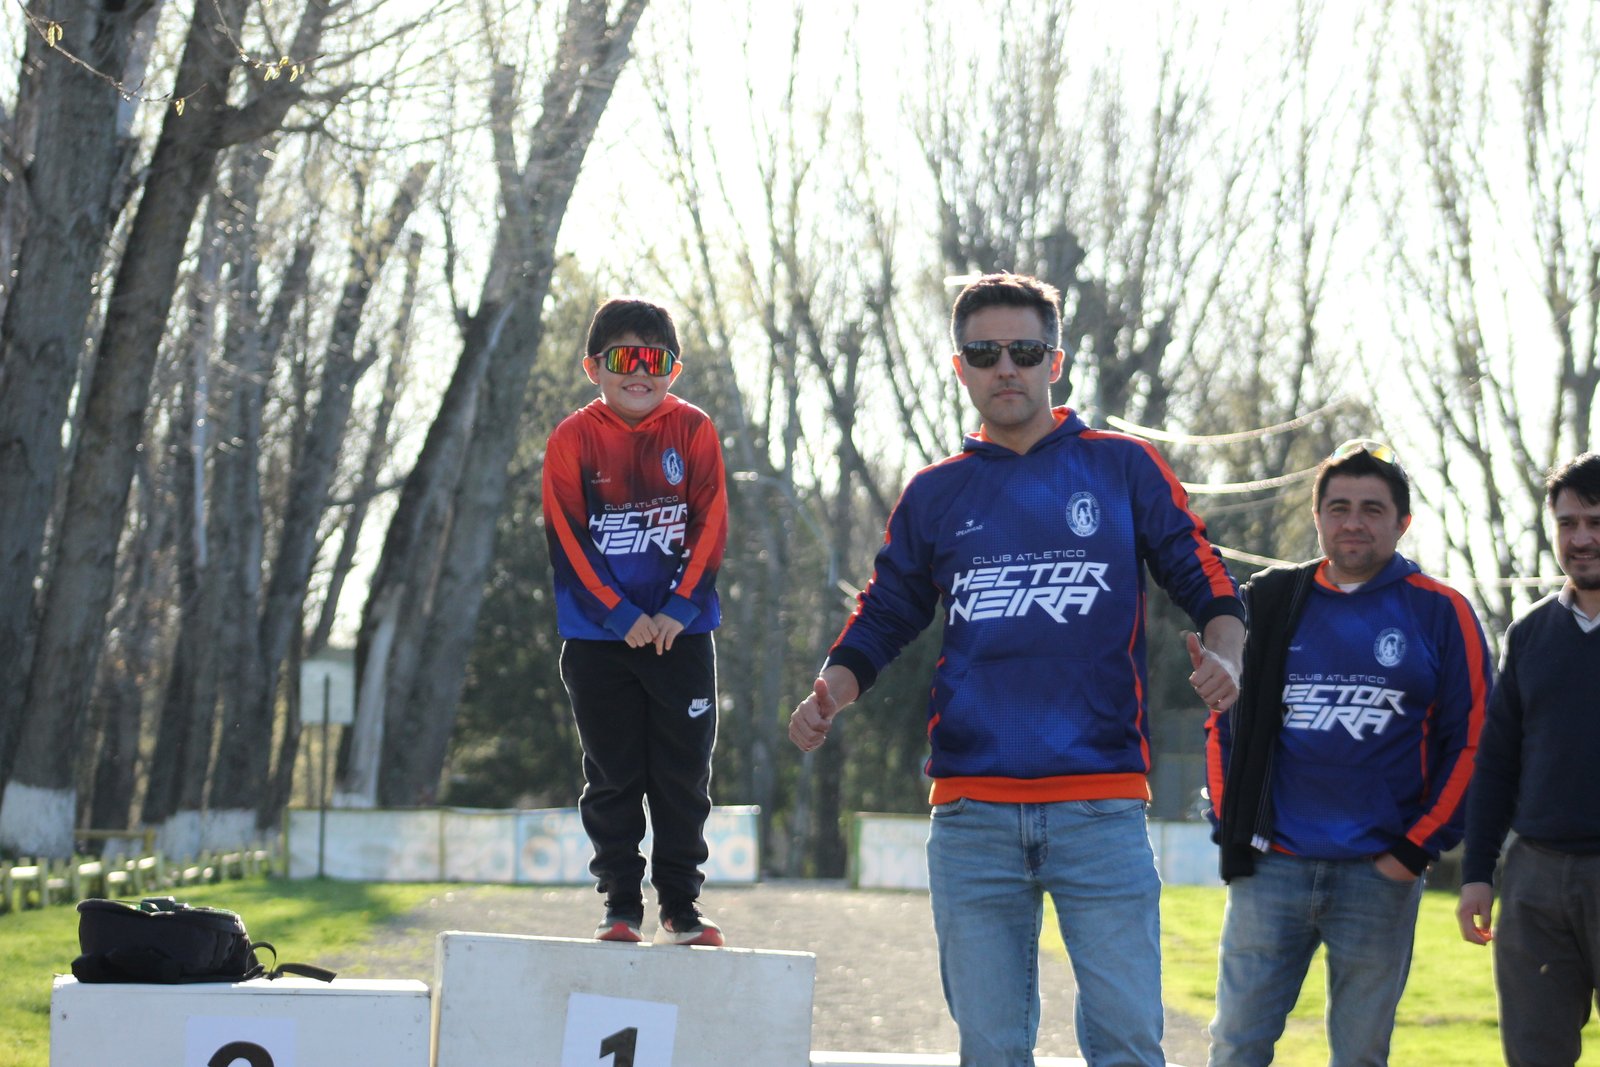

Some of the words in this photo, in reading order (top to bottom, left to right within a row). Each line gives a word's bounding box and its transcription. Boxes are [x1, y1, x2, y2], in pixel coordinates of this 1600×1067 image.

[604, 503, 632, 511] CLUB
[634, 495, 679, 509] ATLETICO
[972, 554, 1012, 565] CLUB
[1015, 549, 1087, 561] ATLETICO
[951, 561, 1112, 595] HECTOR
[949, 586, 1100, 626] NEIRA
[1288, 673, 1323, 682] CLUB
[1325, 674, 1387, 685] ATLETICO
[691, 698, 709, 710] NIKE
